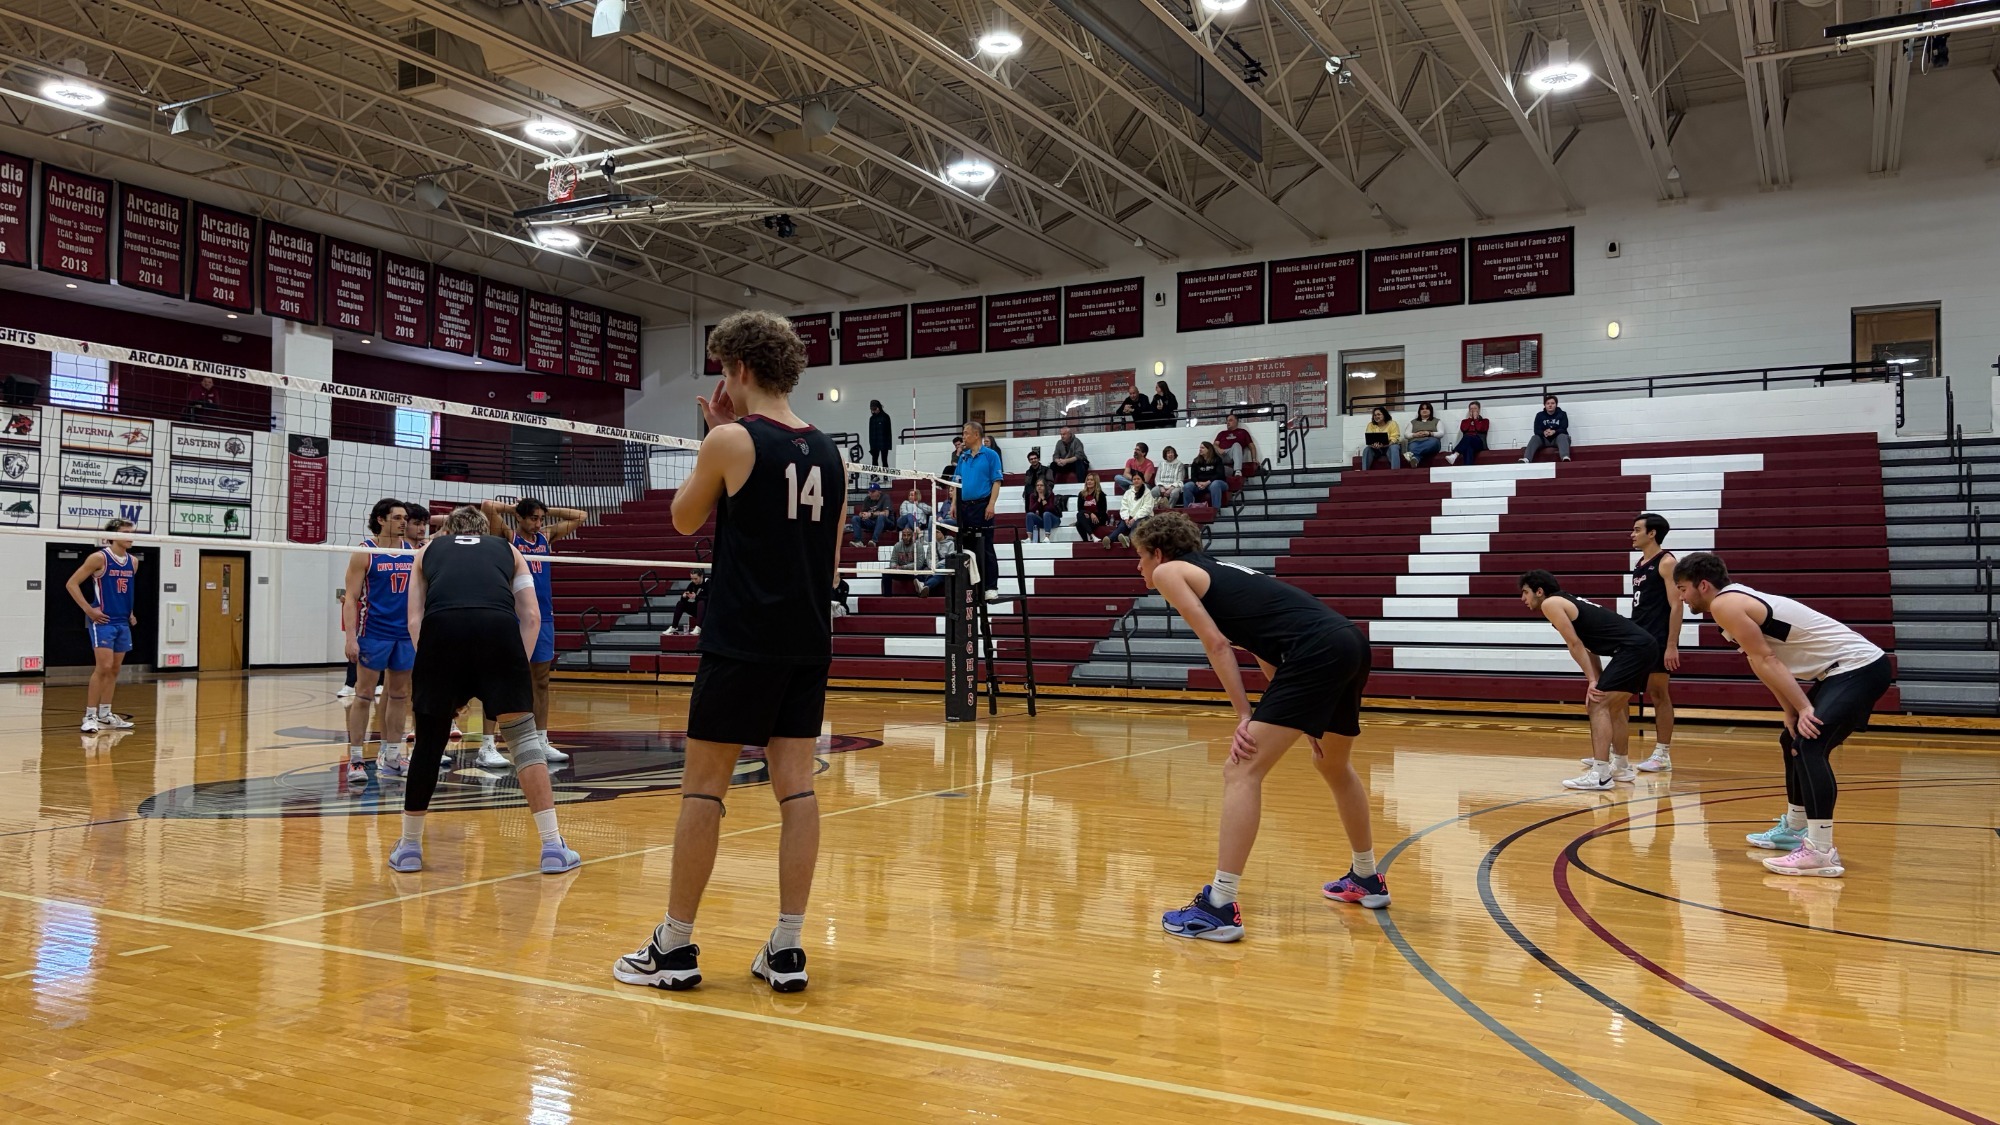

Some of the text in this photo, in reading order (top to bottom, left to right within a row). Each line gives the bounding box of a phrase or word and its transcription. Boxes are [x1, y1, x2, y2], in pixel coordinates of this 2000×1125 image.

[49, 176, 105, 203] Arcadia
[49, 193, 104, 219] University
[127, 193, 179, 220] Arcadia
[49, 213, 103, 233] Women's Soccer
[126, 210, 179, 235] University
[201, 213, 250, 239] Arcadia
[57, 228, 94, 244] ECAC South
[124, 229, 180, 250] Women's Lacrosse
[201, 229, 250, 253] University
[269, 229, 314, 254] Arcadia
[1477, 235, 1566, 251] Athletic Hall of Fame 2024
[58, 239, 93, 256] Champions
[124, 241, 179, 261] Freedom Champions
[268, 244, 313, 267] University
[331, 244, 372, 267] Arcadia
[1374, 247, 1457, 263] Athletic Hall of Fame 2024
[61, 256, 88, 273] 2013
[140, 256, 163, 269] NCAA's
[201, 249, 248, 266] Women's Soccer
[1276, 265, 1300, 273] Athletic
[1321, 261, 1337, 269] Fame
[1338, 258, 1355, 267] 2022
[208, 261, 223, 272] ECAC
[331, 259, 371, 280] University
[387, 260, 425, 281] Arcadia
[138, 269, 163, 286] 2014
[209, 272, 240, 287] Champions
[387, 274, 425, 294] University
[438, 273, 474, 294] Arcadia
[1184, 276, 1207, 284] Athletic
[1207, 274, 1219, 282] Hall
[1242, 270, 1258, 278] 2022
[212, 286, 235, 302] 2014
[438, 286, 474, 306] University
[485, 284, 519, 304] Arcadia
[280, 299, 300, 314] 2015
[485, 298, 519, 316] University
[529, 297, 563, 315] Arcadia
[340, 312, 360, 326] 2016
[529, 310, 563, 327] University
[570, 306, 601, 324] Arcadia
[608, 315, 638, 332] Arcadia
[395, 325, 414, 338] 2016
[570, 318, 601, 335] University
[607, 327, 638, 343] University
[0, 328, 36, 345] GHTS
[445, 337, 464, 350] 2017
[492, 345, 509, 357] 2017
[128, 349, 248, 380] ARCADIA KNIGHTS
[537, 358, 554, 369] 2017
[577, 365, 593, 376] 2018
[1225, 362, 1285, 374] INDOOR TRACK
[615, 372, 630, 383] 2018
[1045, 376, 1101, 387] OUTDOOR TRACK
[1229, 373, 1253, 382] FIELD
[1255, 370, 1291, 379] RECORDS
[320, 382, 413, 406] ARCADIA KNIGHTS
[1051, 387, 1071, 395] FIELD
[1073, 384, 1103, 393] RECORDS
[471, 406, 547, 426] ARCADIA KNIGHTS
[66, 425, 114, 438] ALVERNIA
[596, 425, 660, 443] ARCADIA KNIGHTS
[177, 437, 221, 449] EASTERN
[71, 468, 102, 477] Atlantic
[72, 460, 101, 470] Middle
[862, 464, 901, 476] ARCADIA KNIGHTS
[63, 475, 108, 485] Conference
[114, 474, 144, 486] MAC
[175, 475, 214, 486] MESSIAH
[785, 462, 824, 522] 14
[68, 506, 114, 518] WIDENER
[120, 505, 143, 525] W
[180, 512, 214, 524] YORK
[454, 535, 481, 545] 5
[116, 578, 128, 593] 15
[390, 572, 408, 594] 17
[1633, 590, 1641, 607] 9
[965, 589, 974, 706] KNIGHTS
[25, 657, 39, 669] EXIT
[168, 655, 181, 665] EXIT
